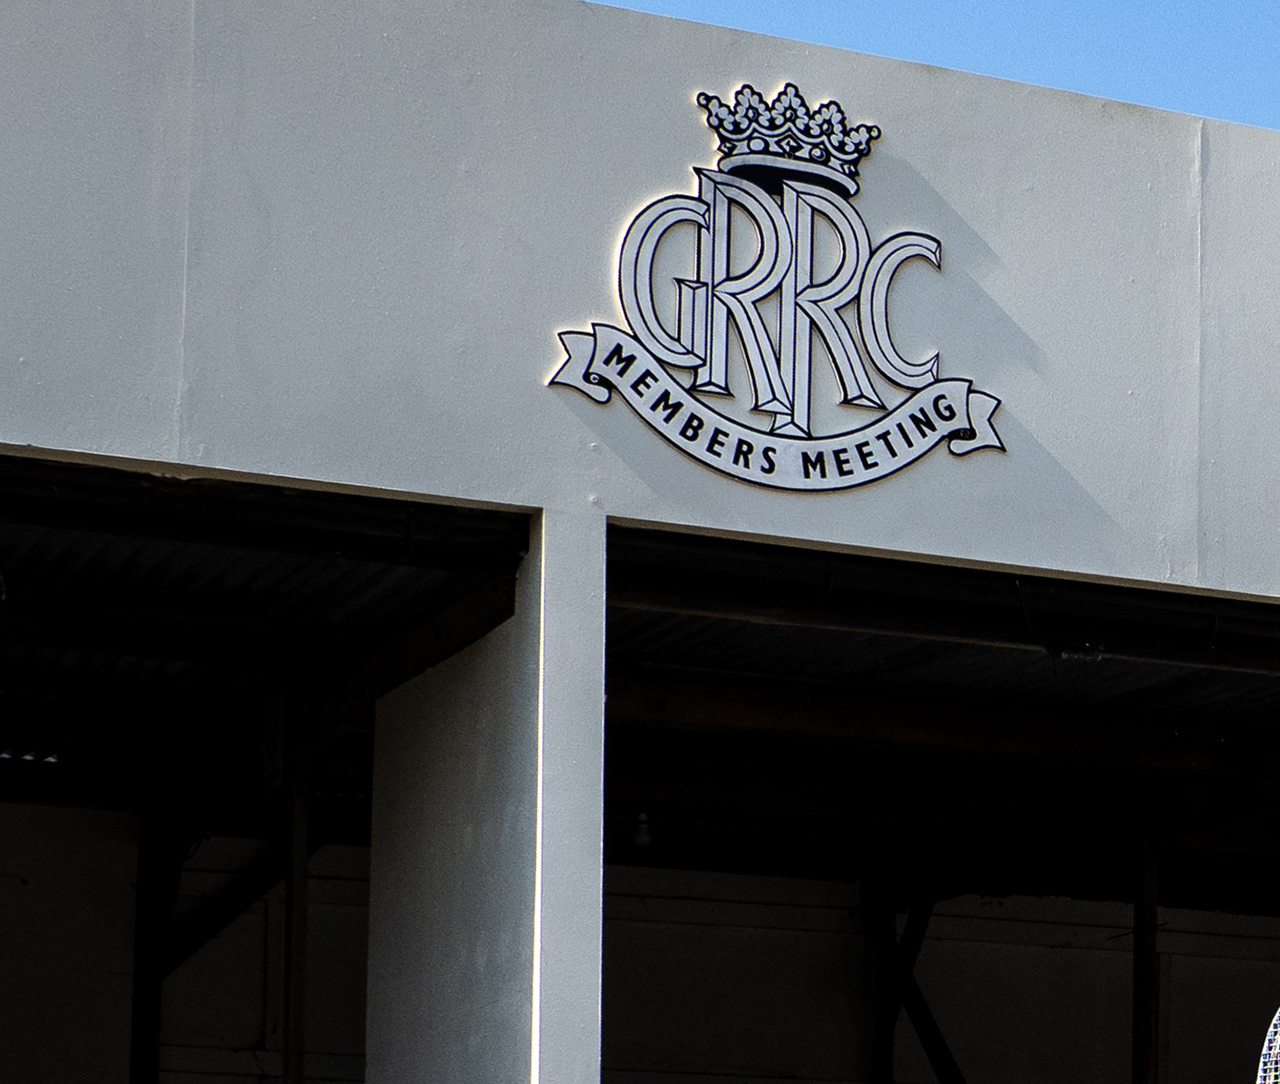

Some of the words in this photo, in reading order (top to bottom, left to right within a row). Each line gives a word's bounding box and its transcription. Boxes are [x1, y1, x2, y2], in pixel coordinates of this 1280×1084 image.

[617, 166, 942, 438] GRRC
[602, 342, 777, 475] MEMBERS
[801, 392, 958, 479] MEETING
